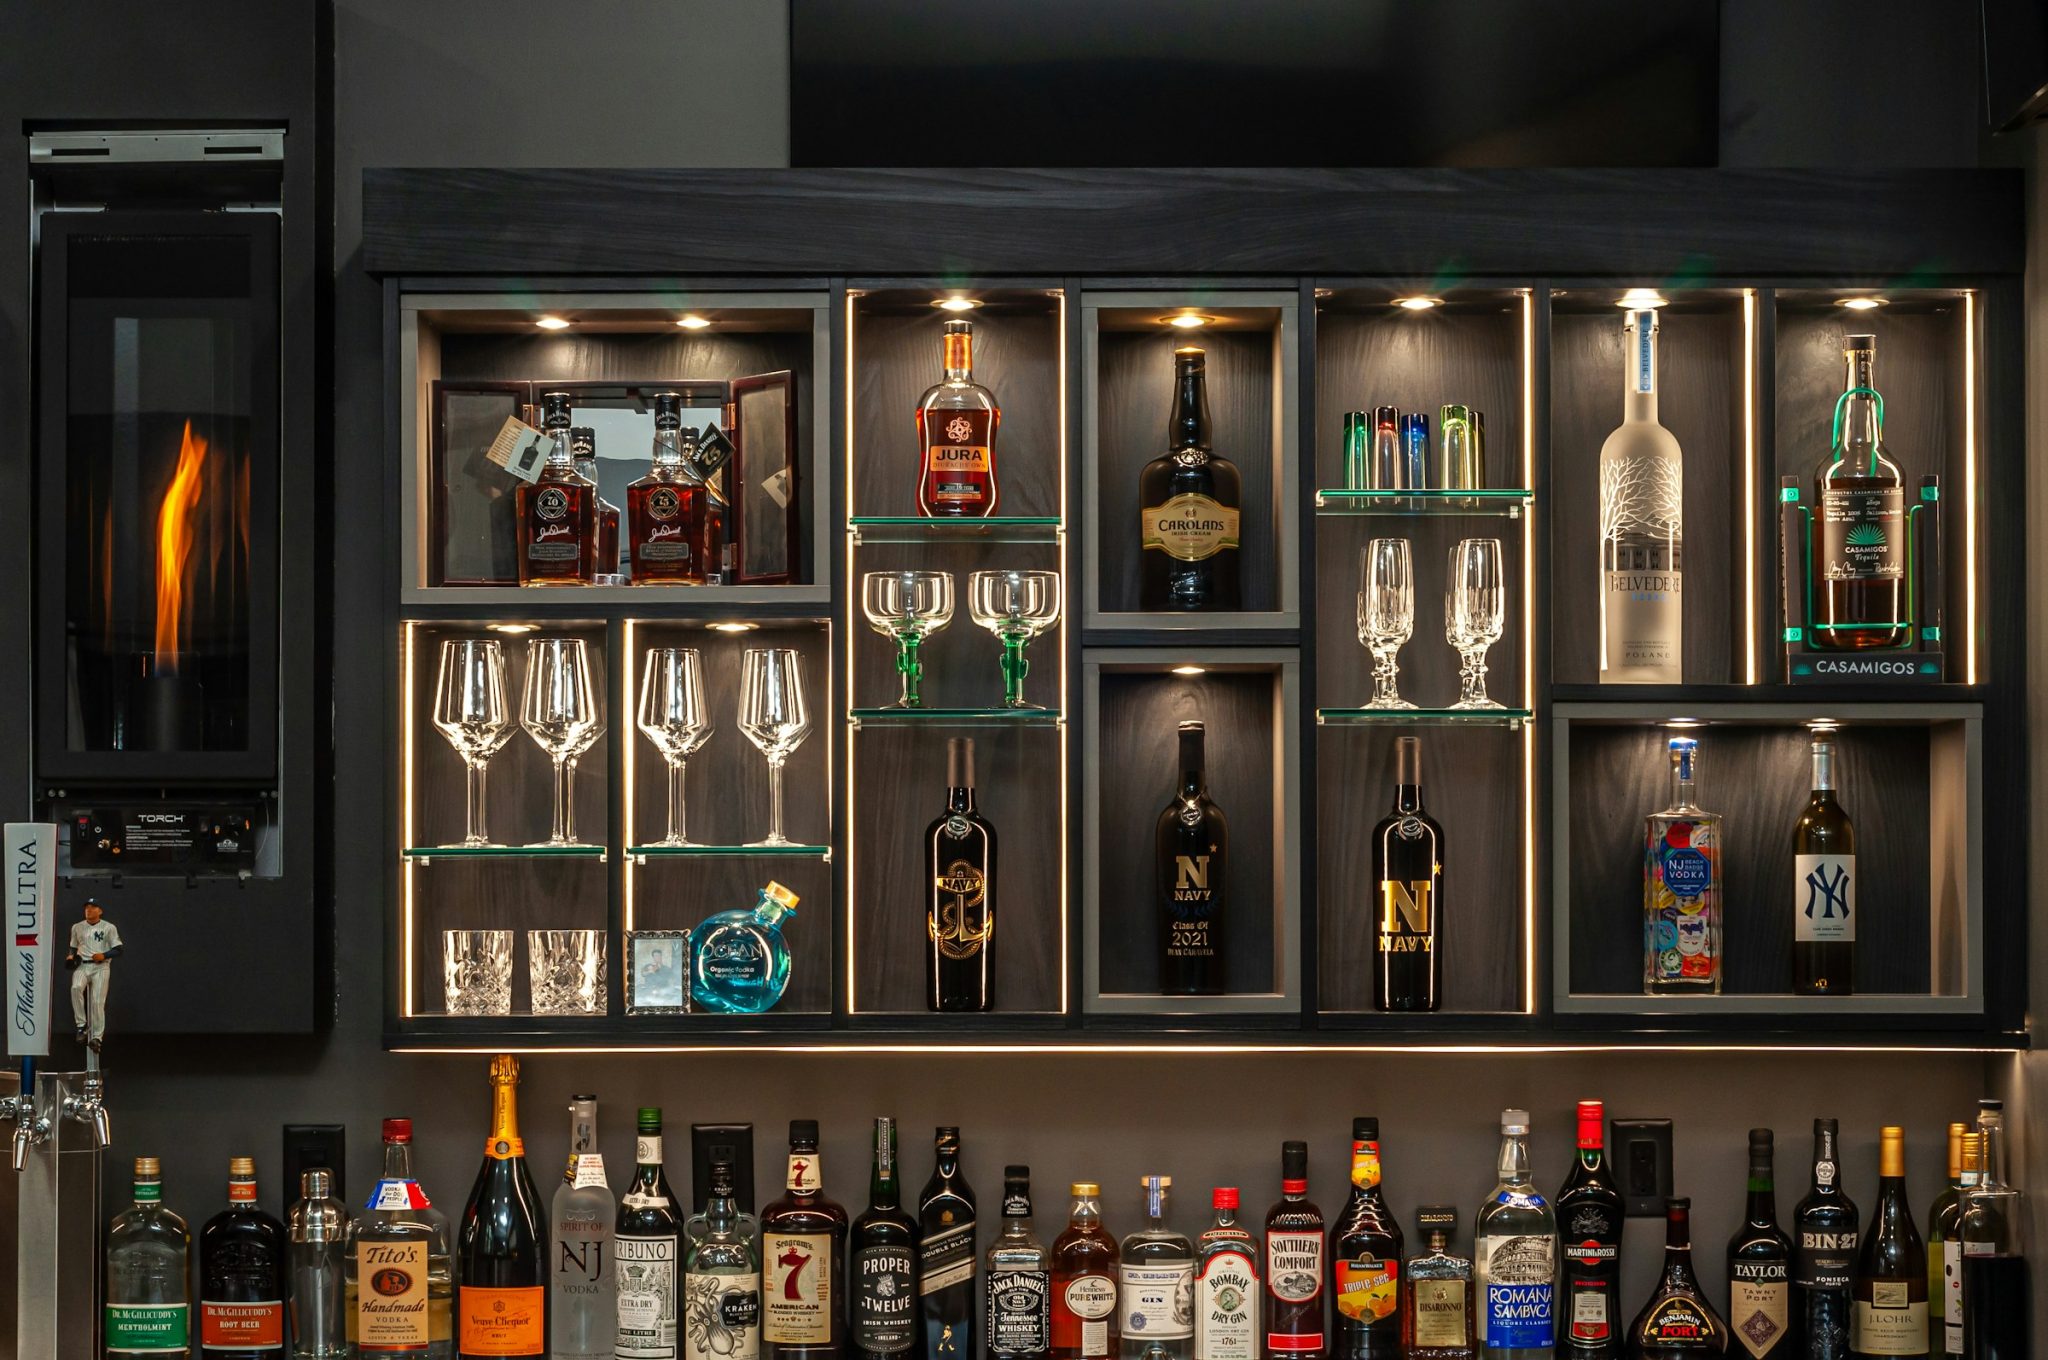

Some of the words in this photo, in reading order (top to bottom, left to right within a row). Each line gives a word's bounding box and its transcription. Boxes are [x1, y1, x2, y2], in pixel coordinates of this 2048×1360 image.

[936, 449, 982, 461] JURA
[1159, 519, 1224, 531] CAROLANS
[1845, 546, 1887, 554] CASAMIGOS
[1611, 575, 1680, 592] BELVEDERE
[1816, 660, 1914, 675] CASAMIGOS
[138, 814, 183, 823] TORCH
[1669, 859, 1683, 870] NJ
[1176, 856, 1210, 889] N
[1669, 870, 1705, 879] VODKA
[17, 839, 37, 930] ULTRA
[942, 878, 979, 891] NAVY
[1804, 862, 1850, 920] NY
[1174, 890, 1211, 901] NAVY
[1381, 880, 1431, 933] N
[1173, 921, 1195, 930] Class
[1172, 931, 1208, 946] 2021
[1379, 935, 1433, 952] NAVY
[700, 943, 763, 958] OCEAN
[15, 951, 35, 1037] Michelob
[560, 1222, 589, 1232] SPIRIT
[614, 1241, 667, 1259] TRIBUNO
[776, 1240, 814, 1250] Seagram's
[921, 1245, 949, 1259] DOUBLE
[1271, 1240, 1320, 1255] SOUTHERN
[366, 1246, 418, 1264] Tito's
[559, 1241, 604, 1282] NJ
[863, 1257, 910, 1275] PROPER
[1274, 1256, 1317, 1270] COMFORT
[778, 1254, 812, 1301] 7
[1735, 1264, 1787, 1278] TAYLOR
[563, 1285, 599, 1294] VODKA
[993, 1277, 1014, 1294] JACK
[1209, 1273, 1250, 1292] BOMBAY
[1070, 1293, 1090, 1301] PURE
[1091, 1293, 1114, 1301] WHITE
[1490, 1287, 1552, 1303] ROMANA
[361, 1299, 426, 1314] Handmade
[621, 1300, 639, 1308] EXTRA
[640, 1300, 653, 1308] DRY
[725, 1304, 757, 1312] KRAKEN
[865, 1295, 910, 1313] TWELVE
[1420, 1303, 1462, 1312] DISARONNO
[471, 1315, 494, 1326] Veuve
[1001, 1311, 1038, 1321] Tennessee
[1211, 1310, 1229, 1324] DRY
[1230, 1311, 1248, 1324] GIN
[1659, 1314, 1700, 1325] BENJAMIN
[118, 1323, 172, 1331] MENTHOLMINT
[1661, 1326, 1698, 1337] PORT
[1221, 1337, 1237, 1345] 1761
